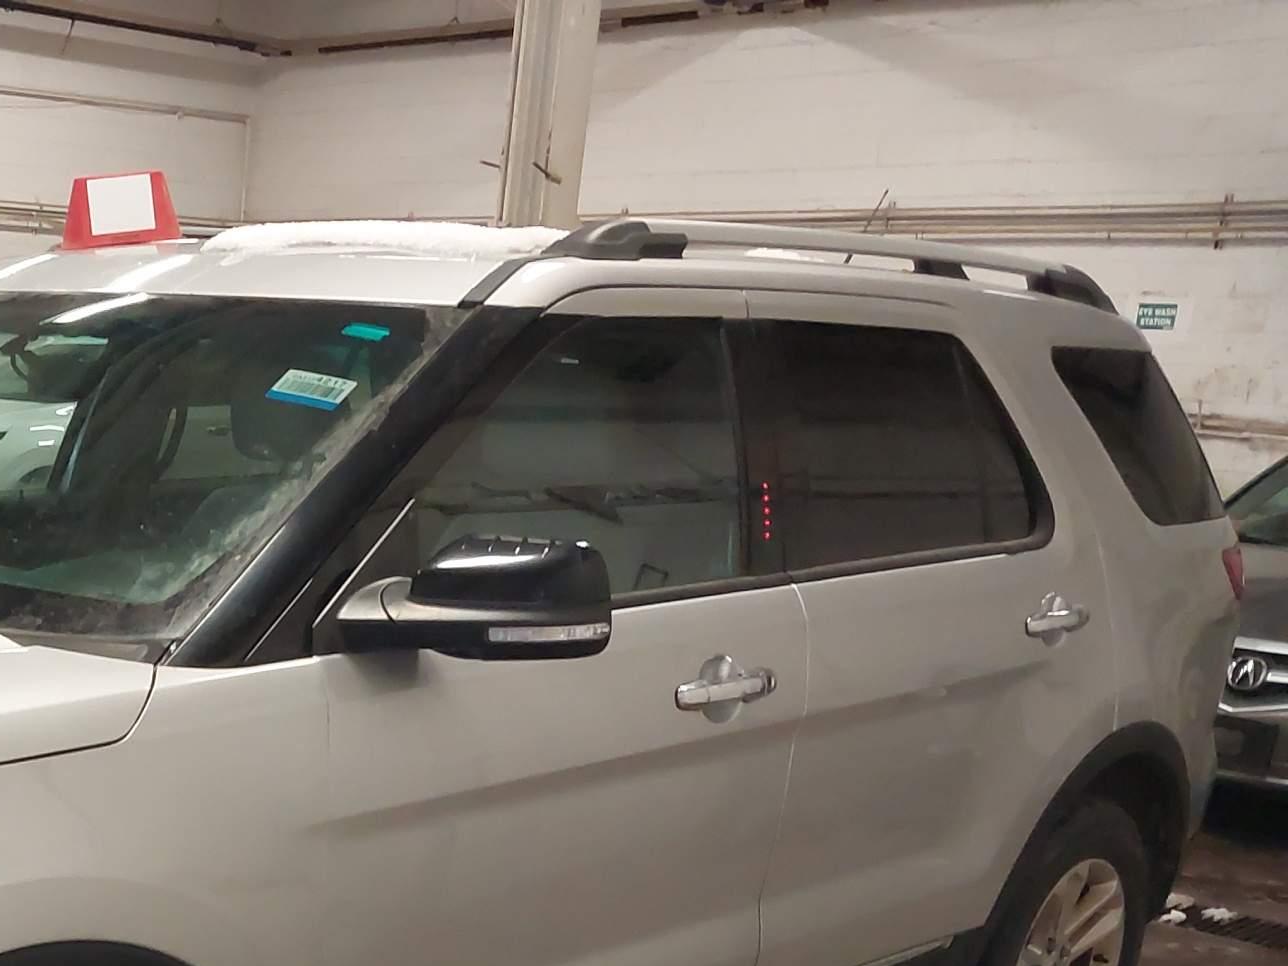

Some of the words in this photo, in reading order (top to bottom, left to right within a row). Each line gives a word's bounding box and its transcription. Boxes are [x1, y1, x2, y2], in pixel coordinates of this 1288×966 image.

[1139, 307, 1153, 316] EYE
[1155, 307, 1176, 317] WASH
[1140, 317, 1171, 327] STATION
